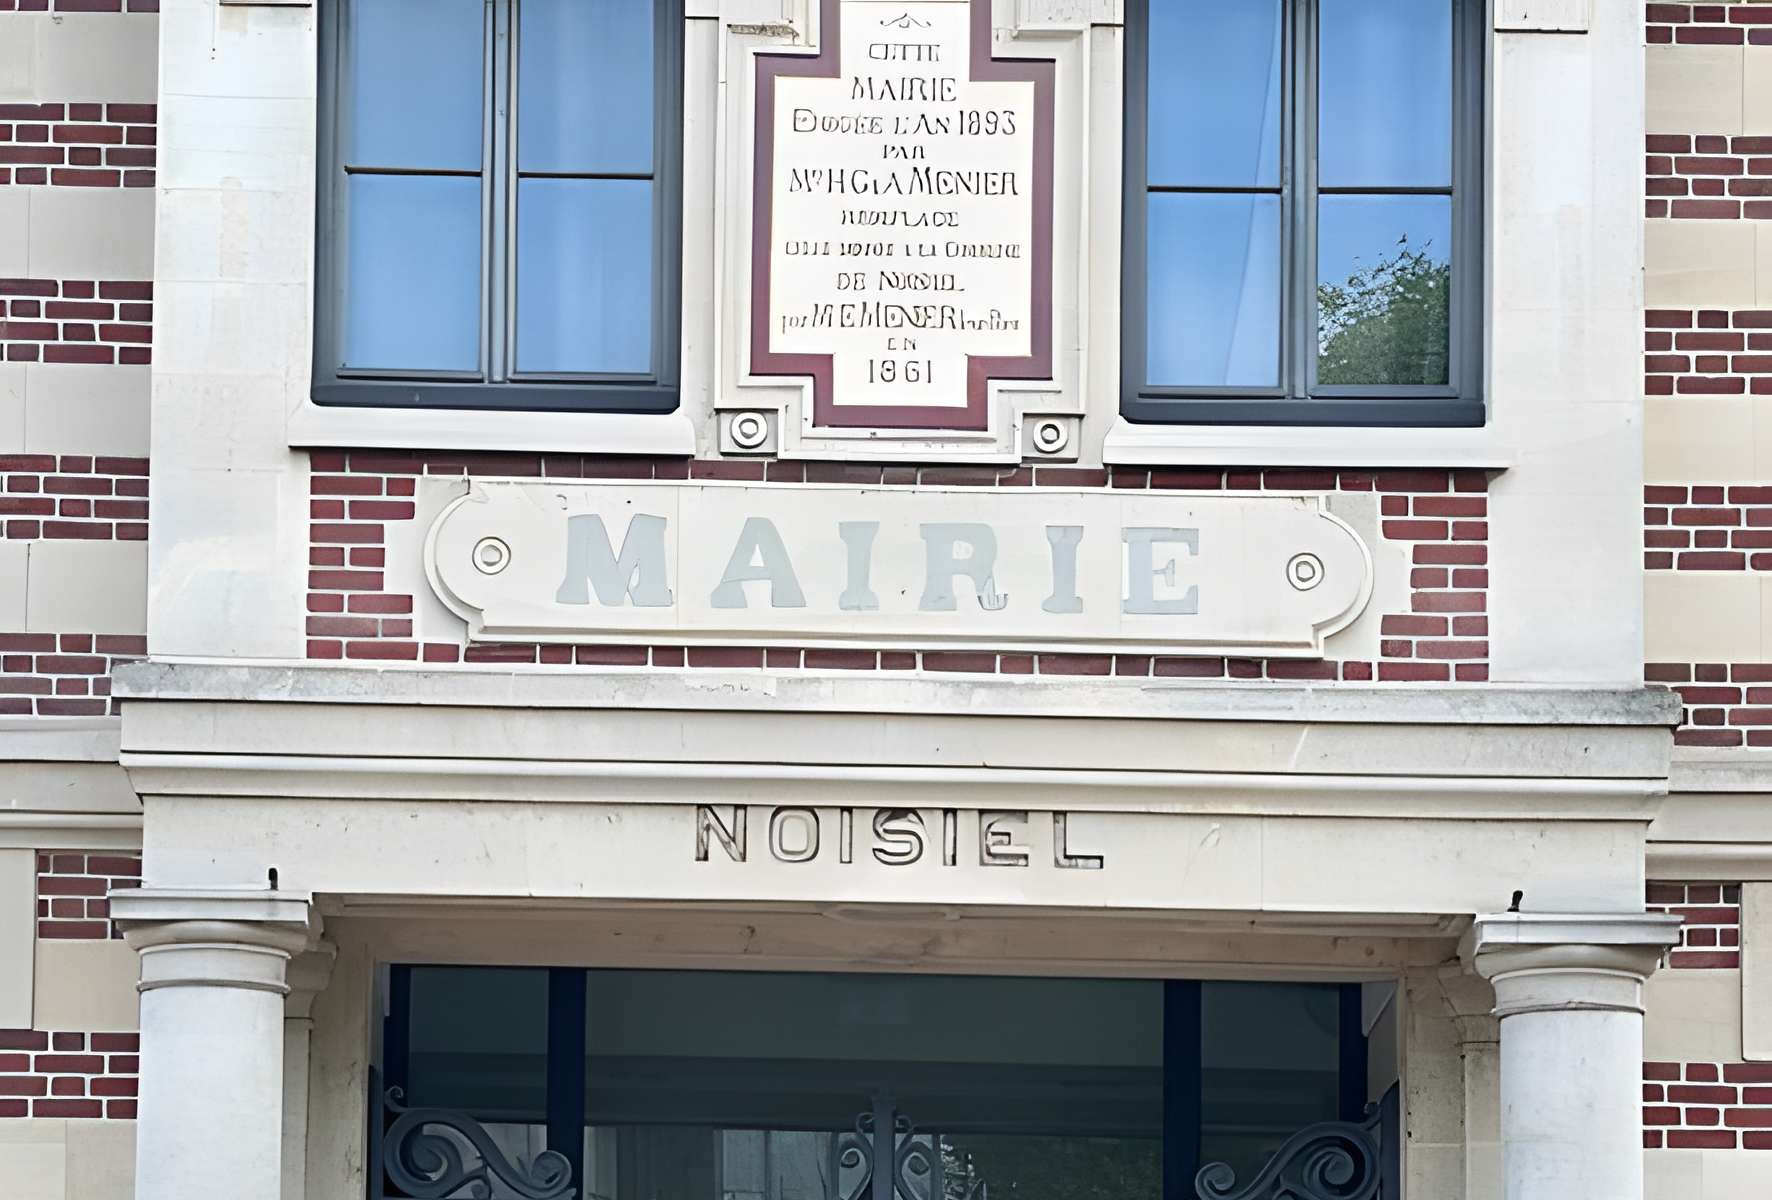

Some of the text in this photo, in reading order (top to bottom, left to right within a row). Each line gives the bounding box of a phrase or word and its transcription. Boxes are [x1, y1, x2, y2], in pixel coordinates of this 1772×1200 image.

[852, 76, 957, 102] MAIRIE
[556, 513, 1201, 616] MAIRIE
[694, 804, 1104, 870] NOISIEL
